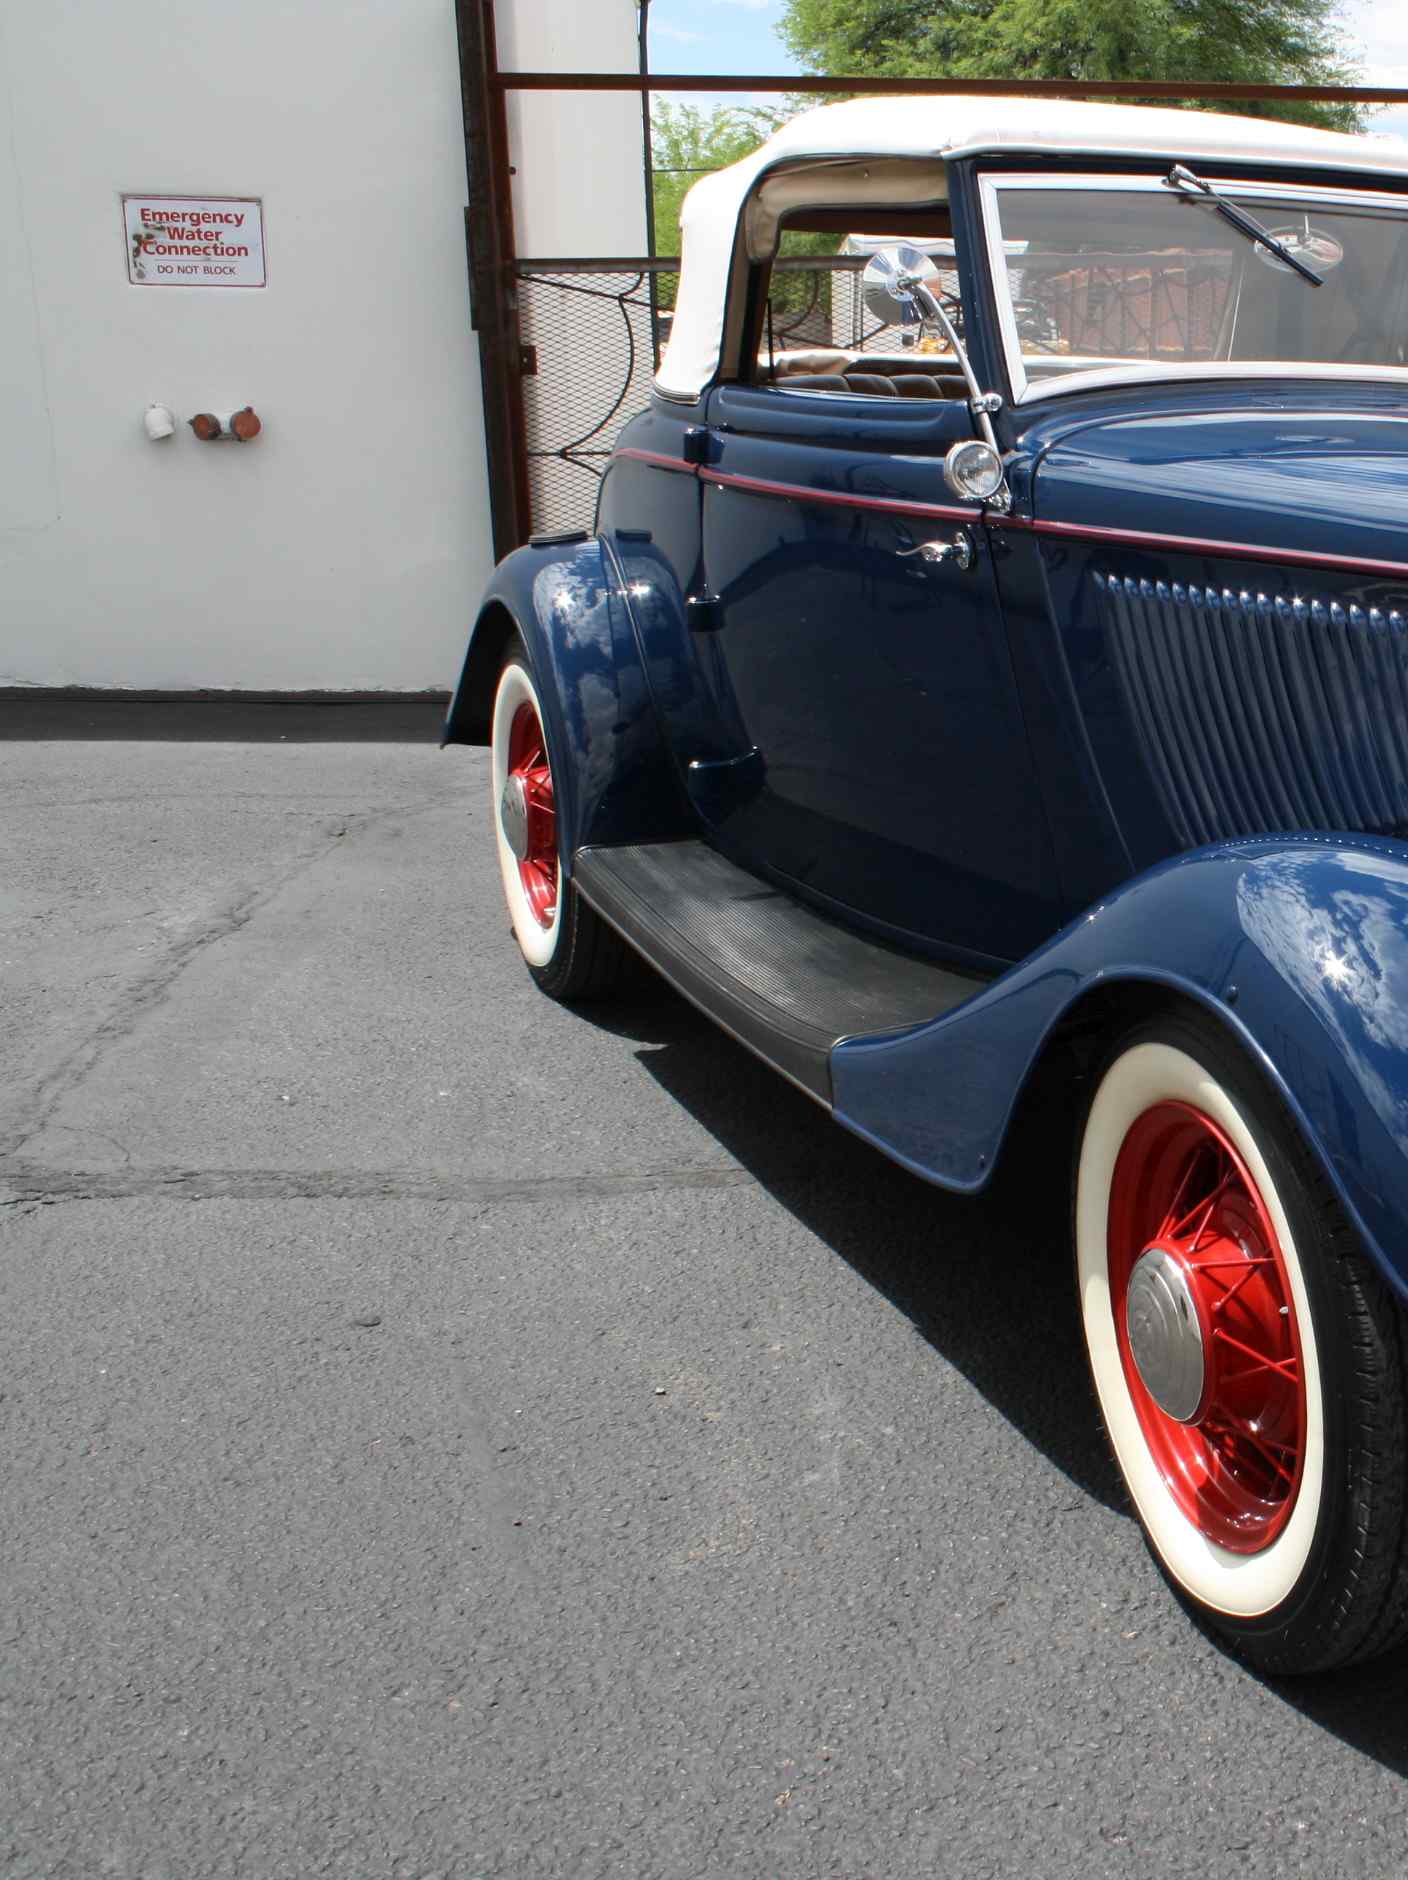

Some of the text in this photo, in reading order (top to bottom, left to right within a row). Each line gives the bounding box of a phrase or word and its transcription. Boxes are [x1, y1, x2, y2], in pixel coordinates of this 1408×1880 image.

[140, 208, 245, 228] Emergency
[166, 226, 223, 241] Water
[142, 240, 249, 257] Connection
[157, 264, 236, 275] DO NOT BLOCK
